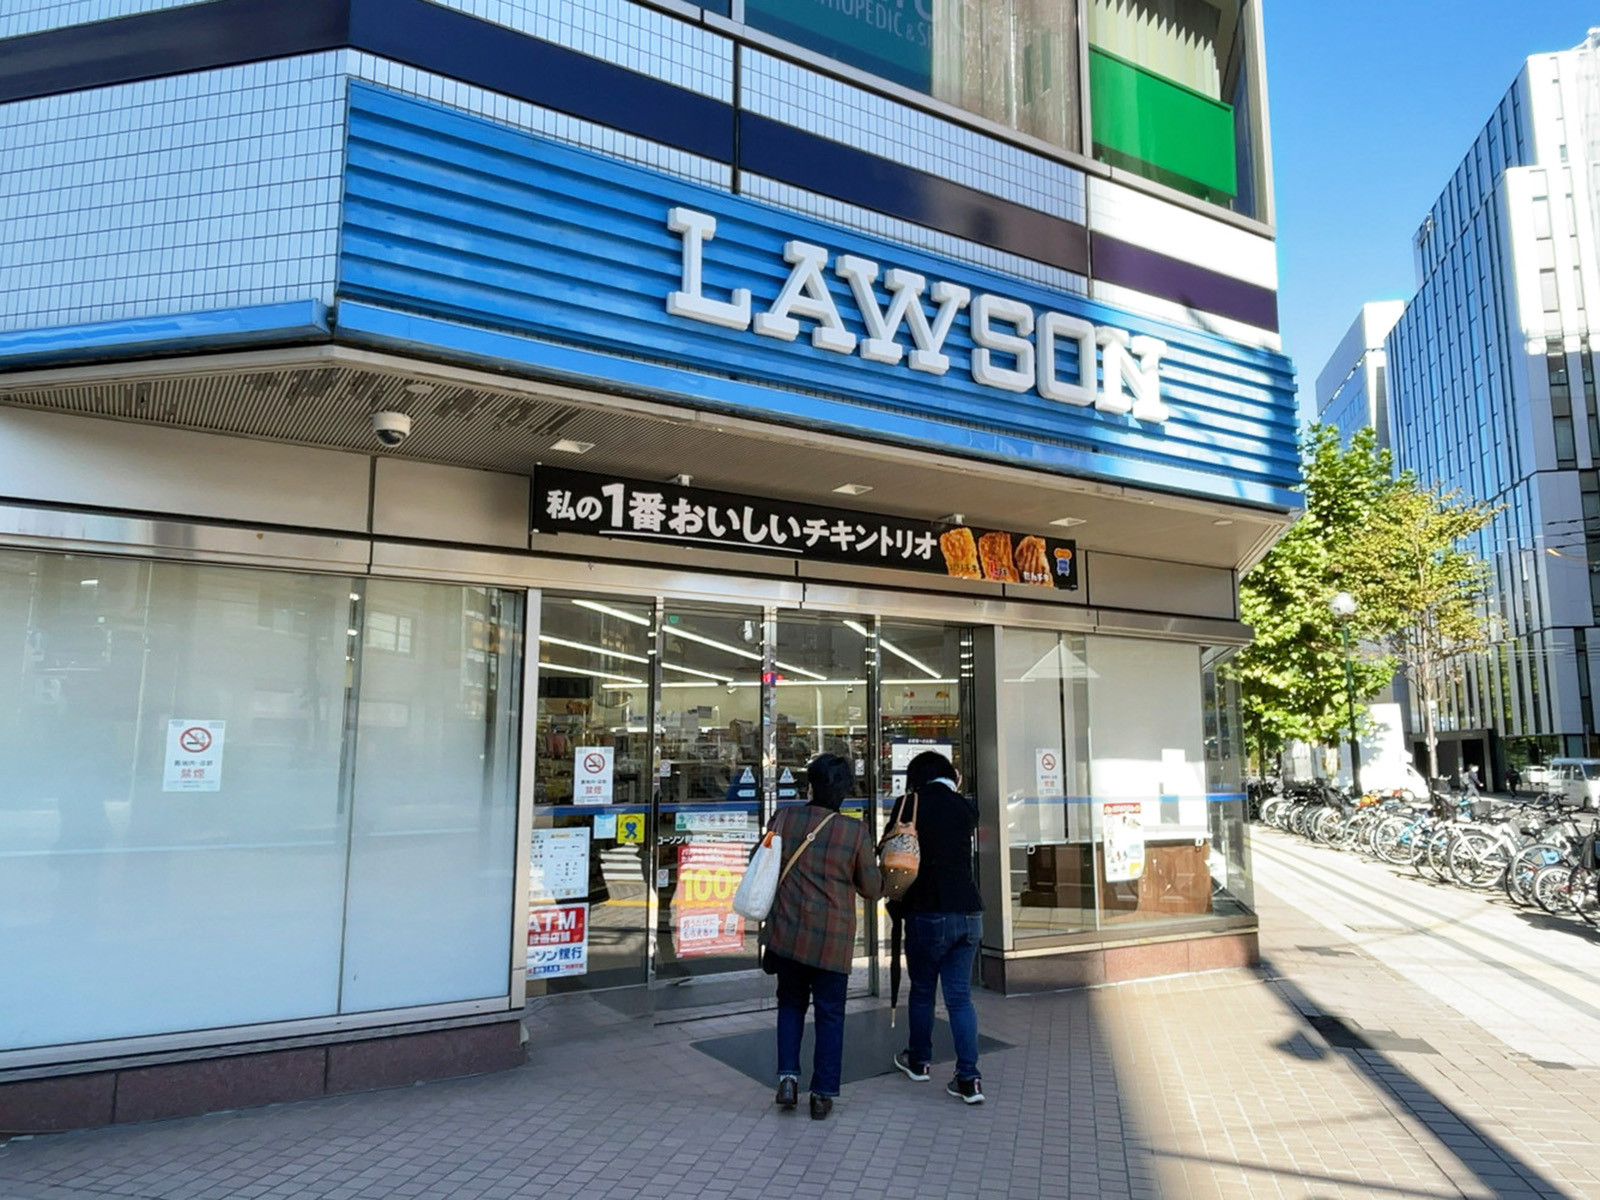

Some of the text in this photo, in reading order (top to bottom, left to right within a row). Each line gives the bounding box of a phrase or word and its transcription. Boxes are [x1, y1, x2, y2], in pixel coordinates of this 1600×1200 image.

[666, 206, 1170, 424] LAWSON
[546, 483, 938, 561] 私の1番おいしいチキントリオ
[528, 909, 577, 933] ATM
